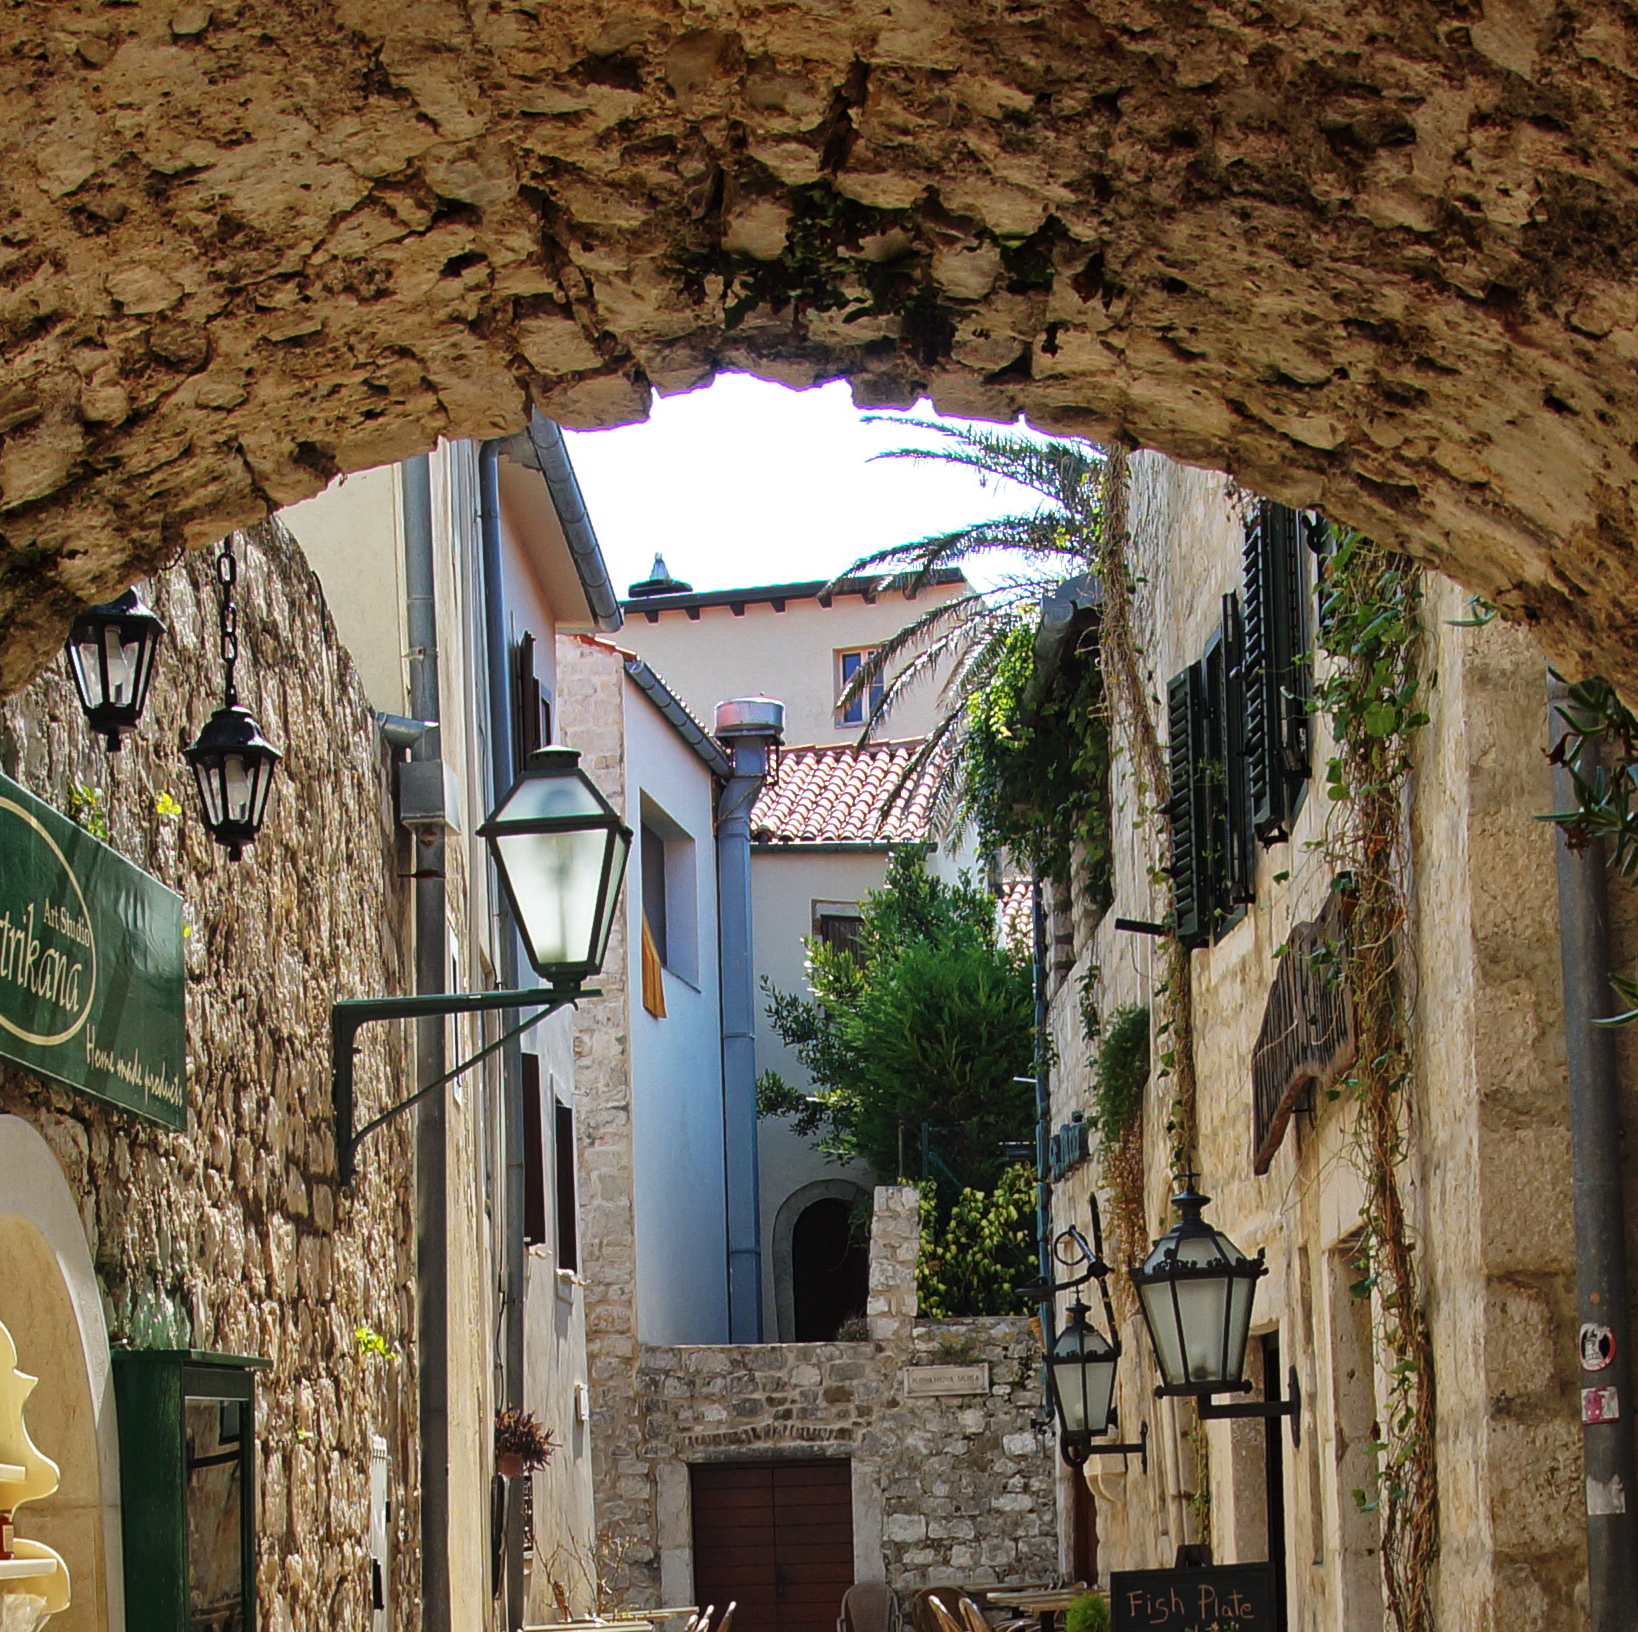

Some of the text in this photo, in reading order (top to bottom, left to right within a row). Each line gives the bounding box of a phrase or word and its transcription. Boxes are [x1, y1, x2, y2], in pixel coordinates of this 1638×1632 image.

[43, 897, 90, 947] Art Studio
[86, 1023, 115, 1073] Home
[1126, 1584, 1255, 1624] Fish Plate
